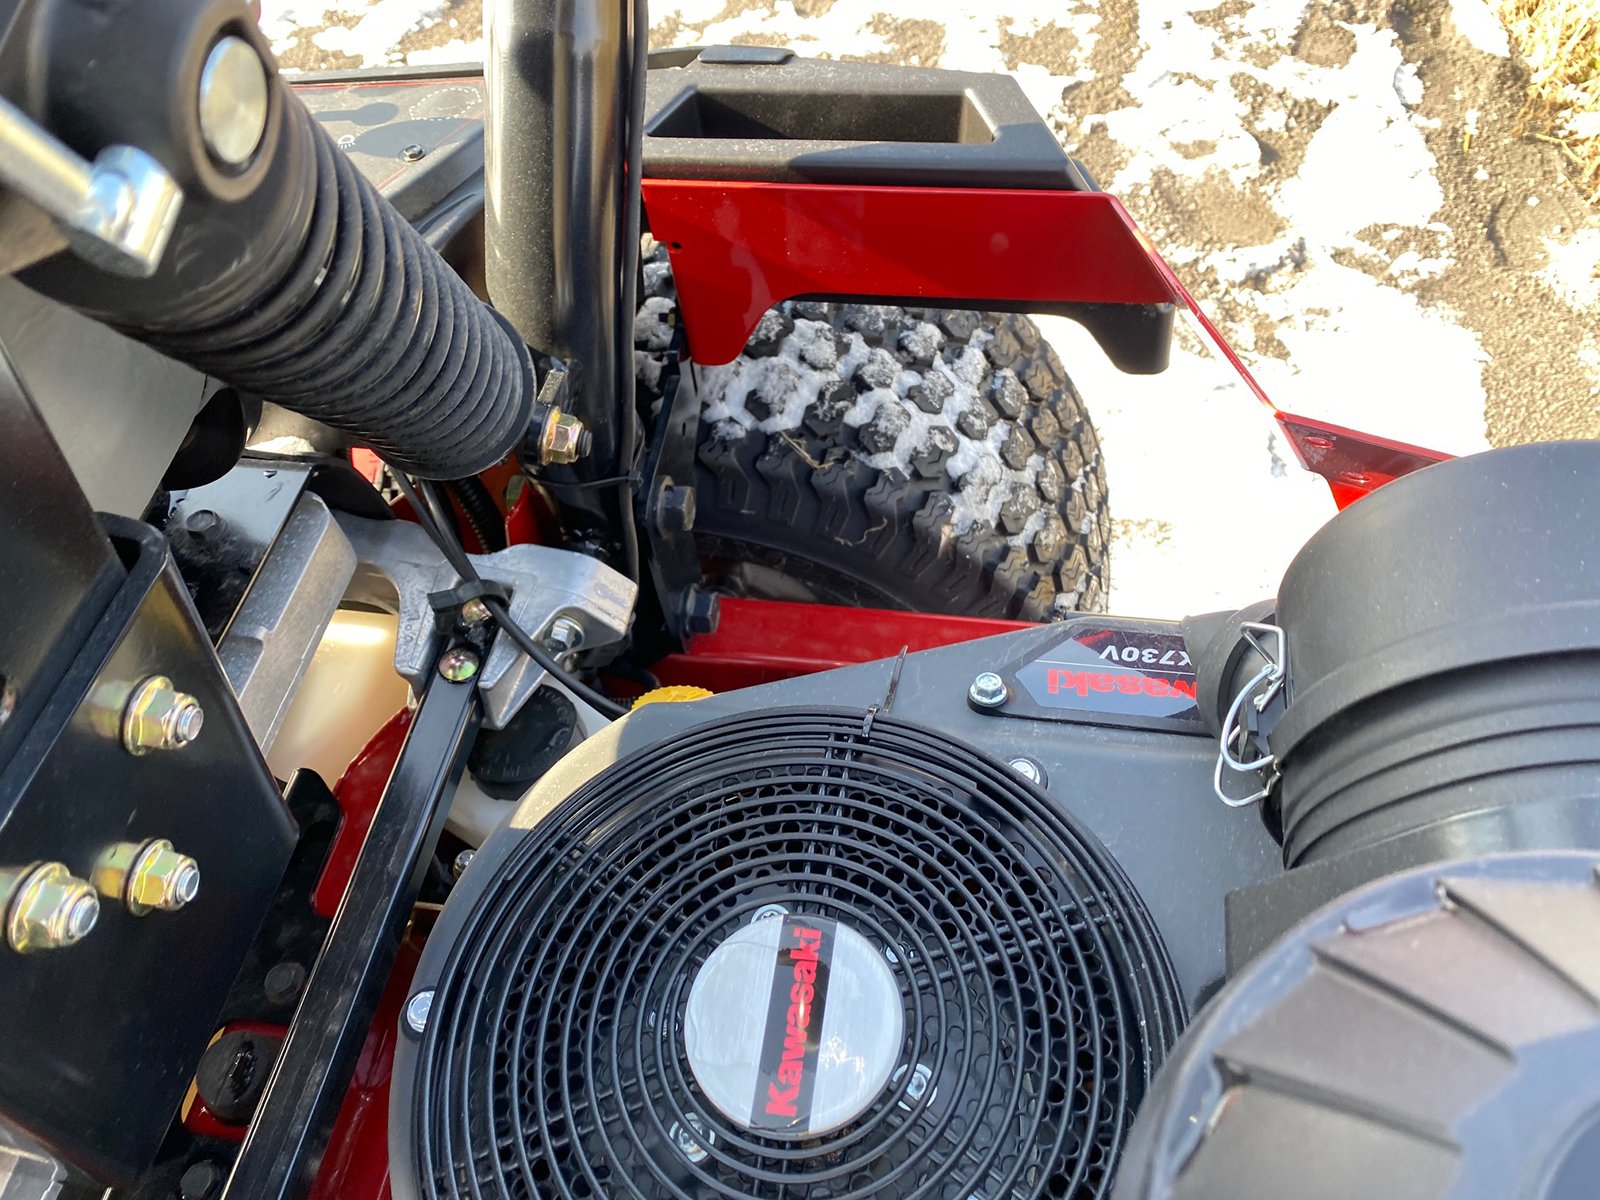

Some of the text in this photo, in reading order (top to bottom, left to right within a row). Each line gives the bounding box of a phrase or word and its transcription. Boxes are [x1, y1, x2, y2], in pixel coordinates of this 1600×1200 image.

[1099, 645, 1193, 667] X730V
[1047, 668, 1197, 699] wasaki
[765, 927, 822, 1116] Kawasaki
